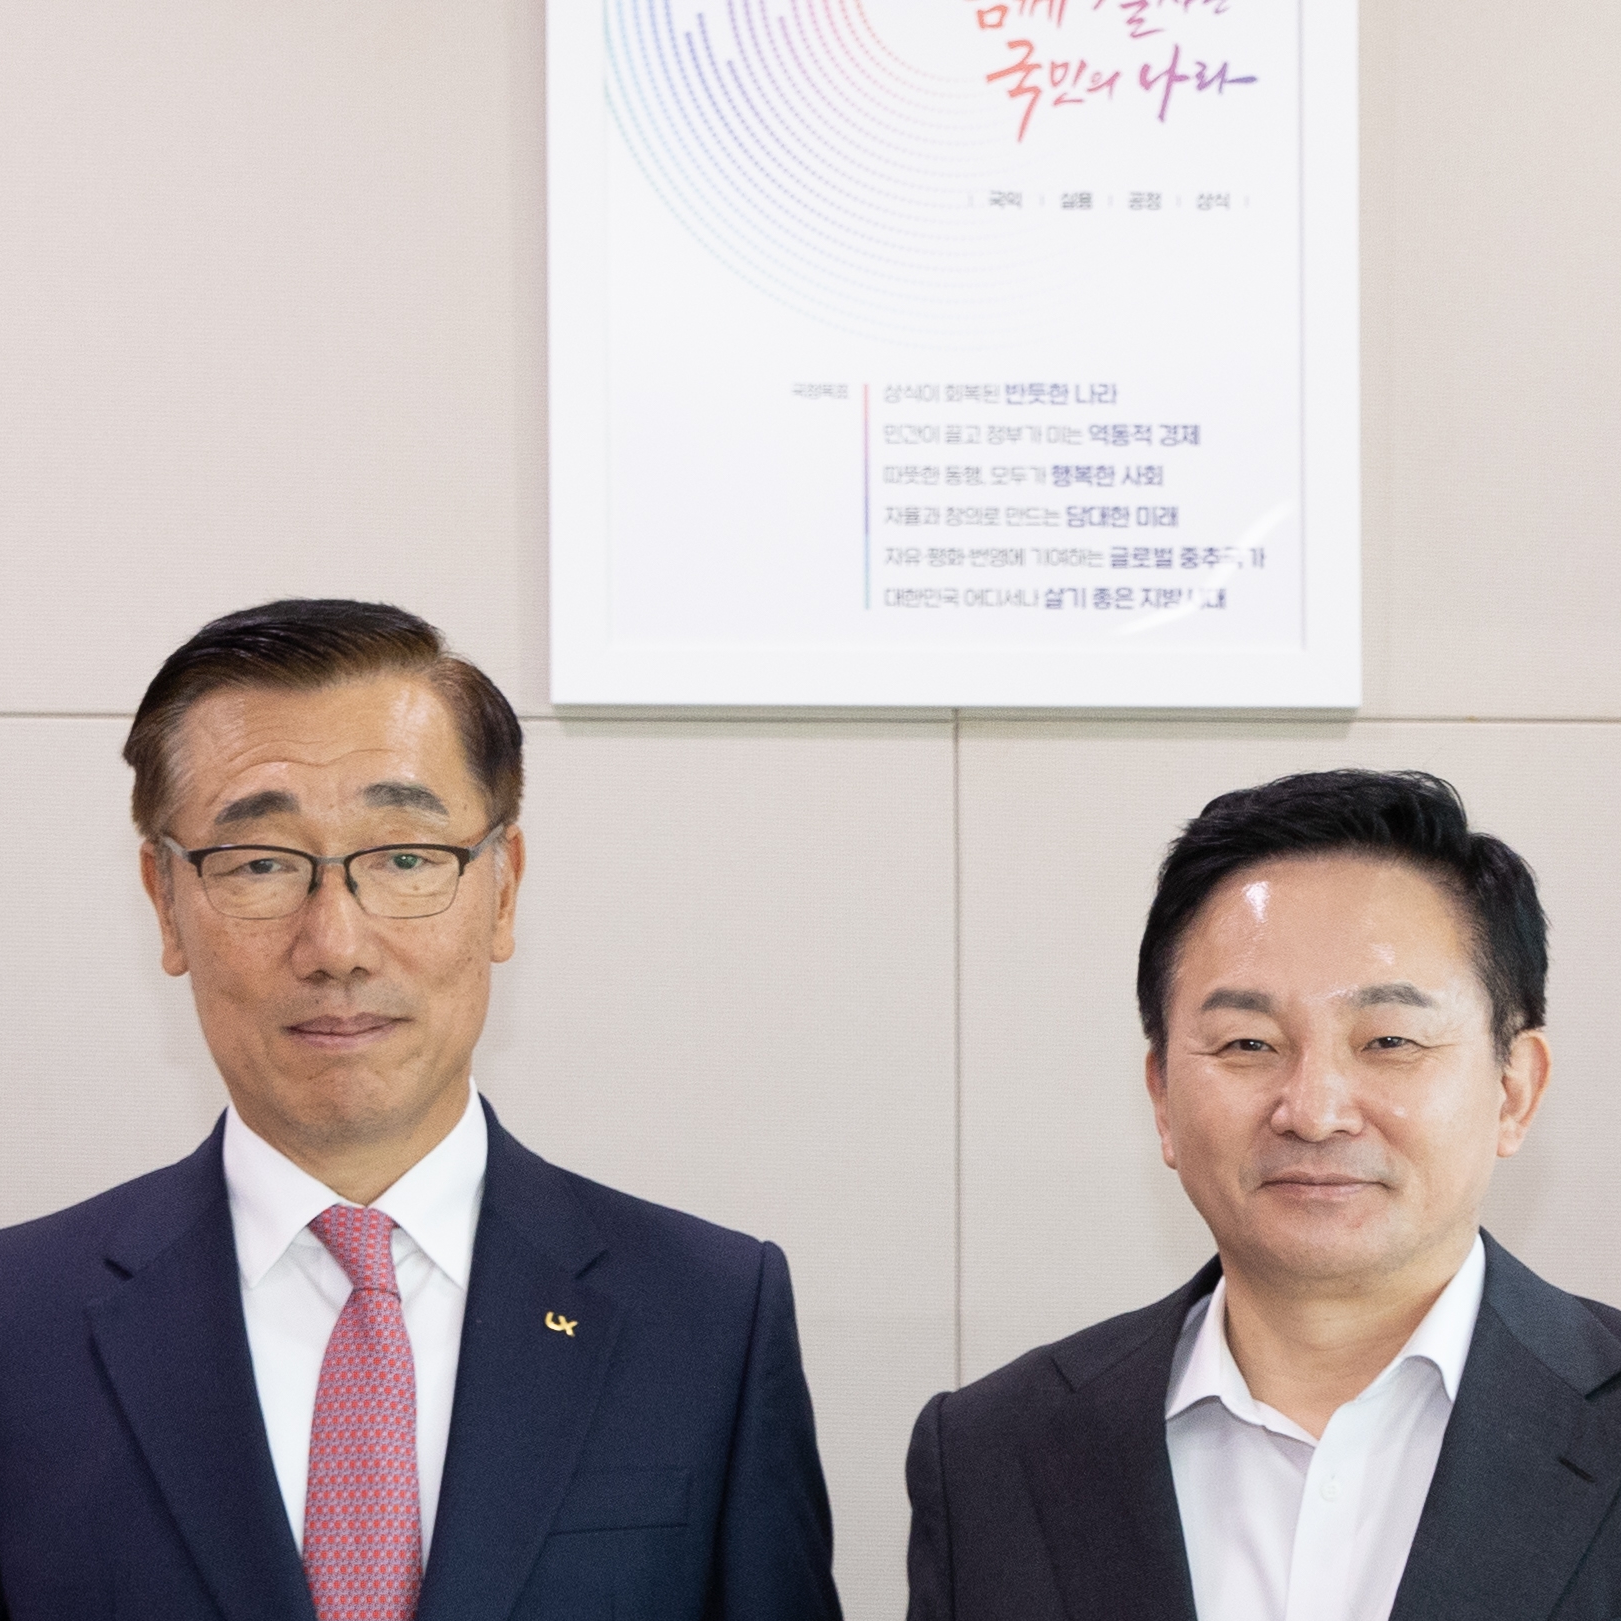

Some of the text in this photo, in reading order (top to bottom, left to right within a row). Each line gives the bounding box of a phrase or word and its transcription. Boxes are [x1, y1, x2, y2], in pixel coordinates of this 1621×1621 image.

[986, 39, 1258, 143] 국민의 나라
[884, 383, 940, 403] 상식이
[1003, 383, 1070, 405] 반듯한
[1074, 383, 1118, 405] 나라
[884, 424, 940, 444] 민간이
[987, 424, 1042, 444] 정부가
[1046, 424, 1082, 444] 미는
[1087, 424, 1153, 446] 역동적
[1158, 424, 1201, 446] 경제
[883, 465, 940, 485] 따뜻한
[991, 465, 1047, 485] 모두가
[1050, 465, 1116, 487] 행복한
[1121, 465, 1164, 487] 사회
[885, 506, 941, 526] 자율과
[1005, 506, 1060, 526] 만드는
[1065, 506, 1131, 528] 담대한
[1135, 506, 1179, 528] 미래
[1031, 547, 1103, 567] 기여하는
[1109, 547, 1174, 569] 글로벌
[884, 588, 959, 608] 대한민국
[1043, 588, 1087, 610] 살기
[1092, 588, 1135, 610] 좋은
